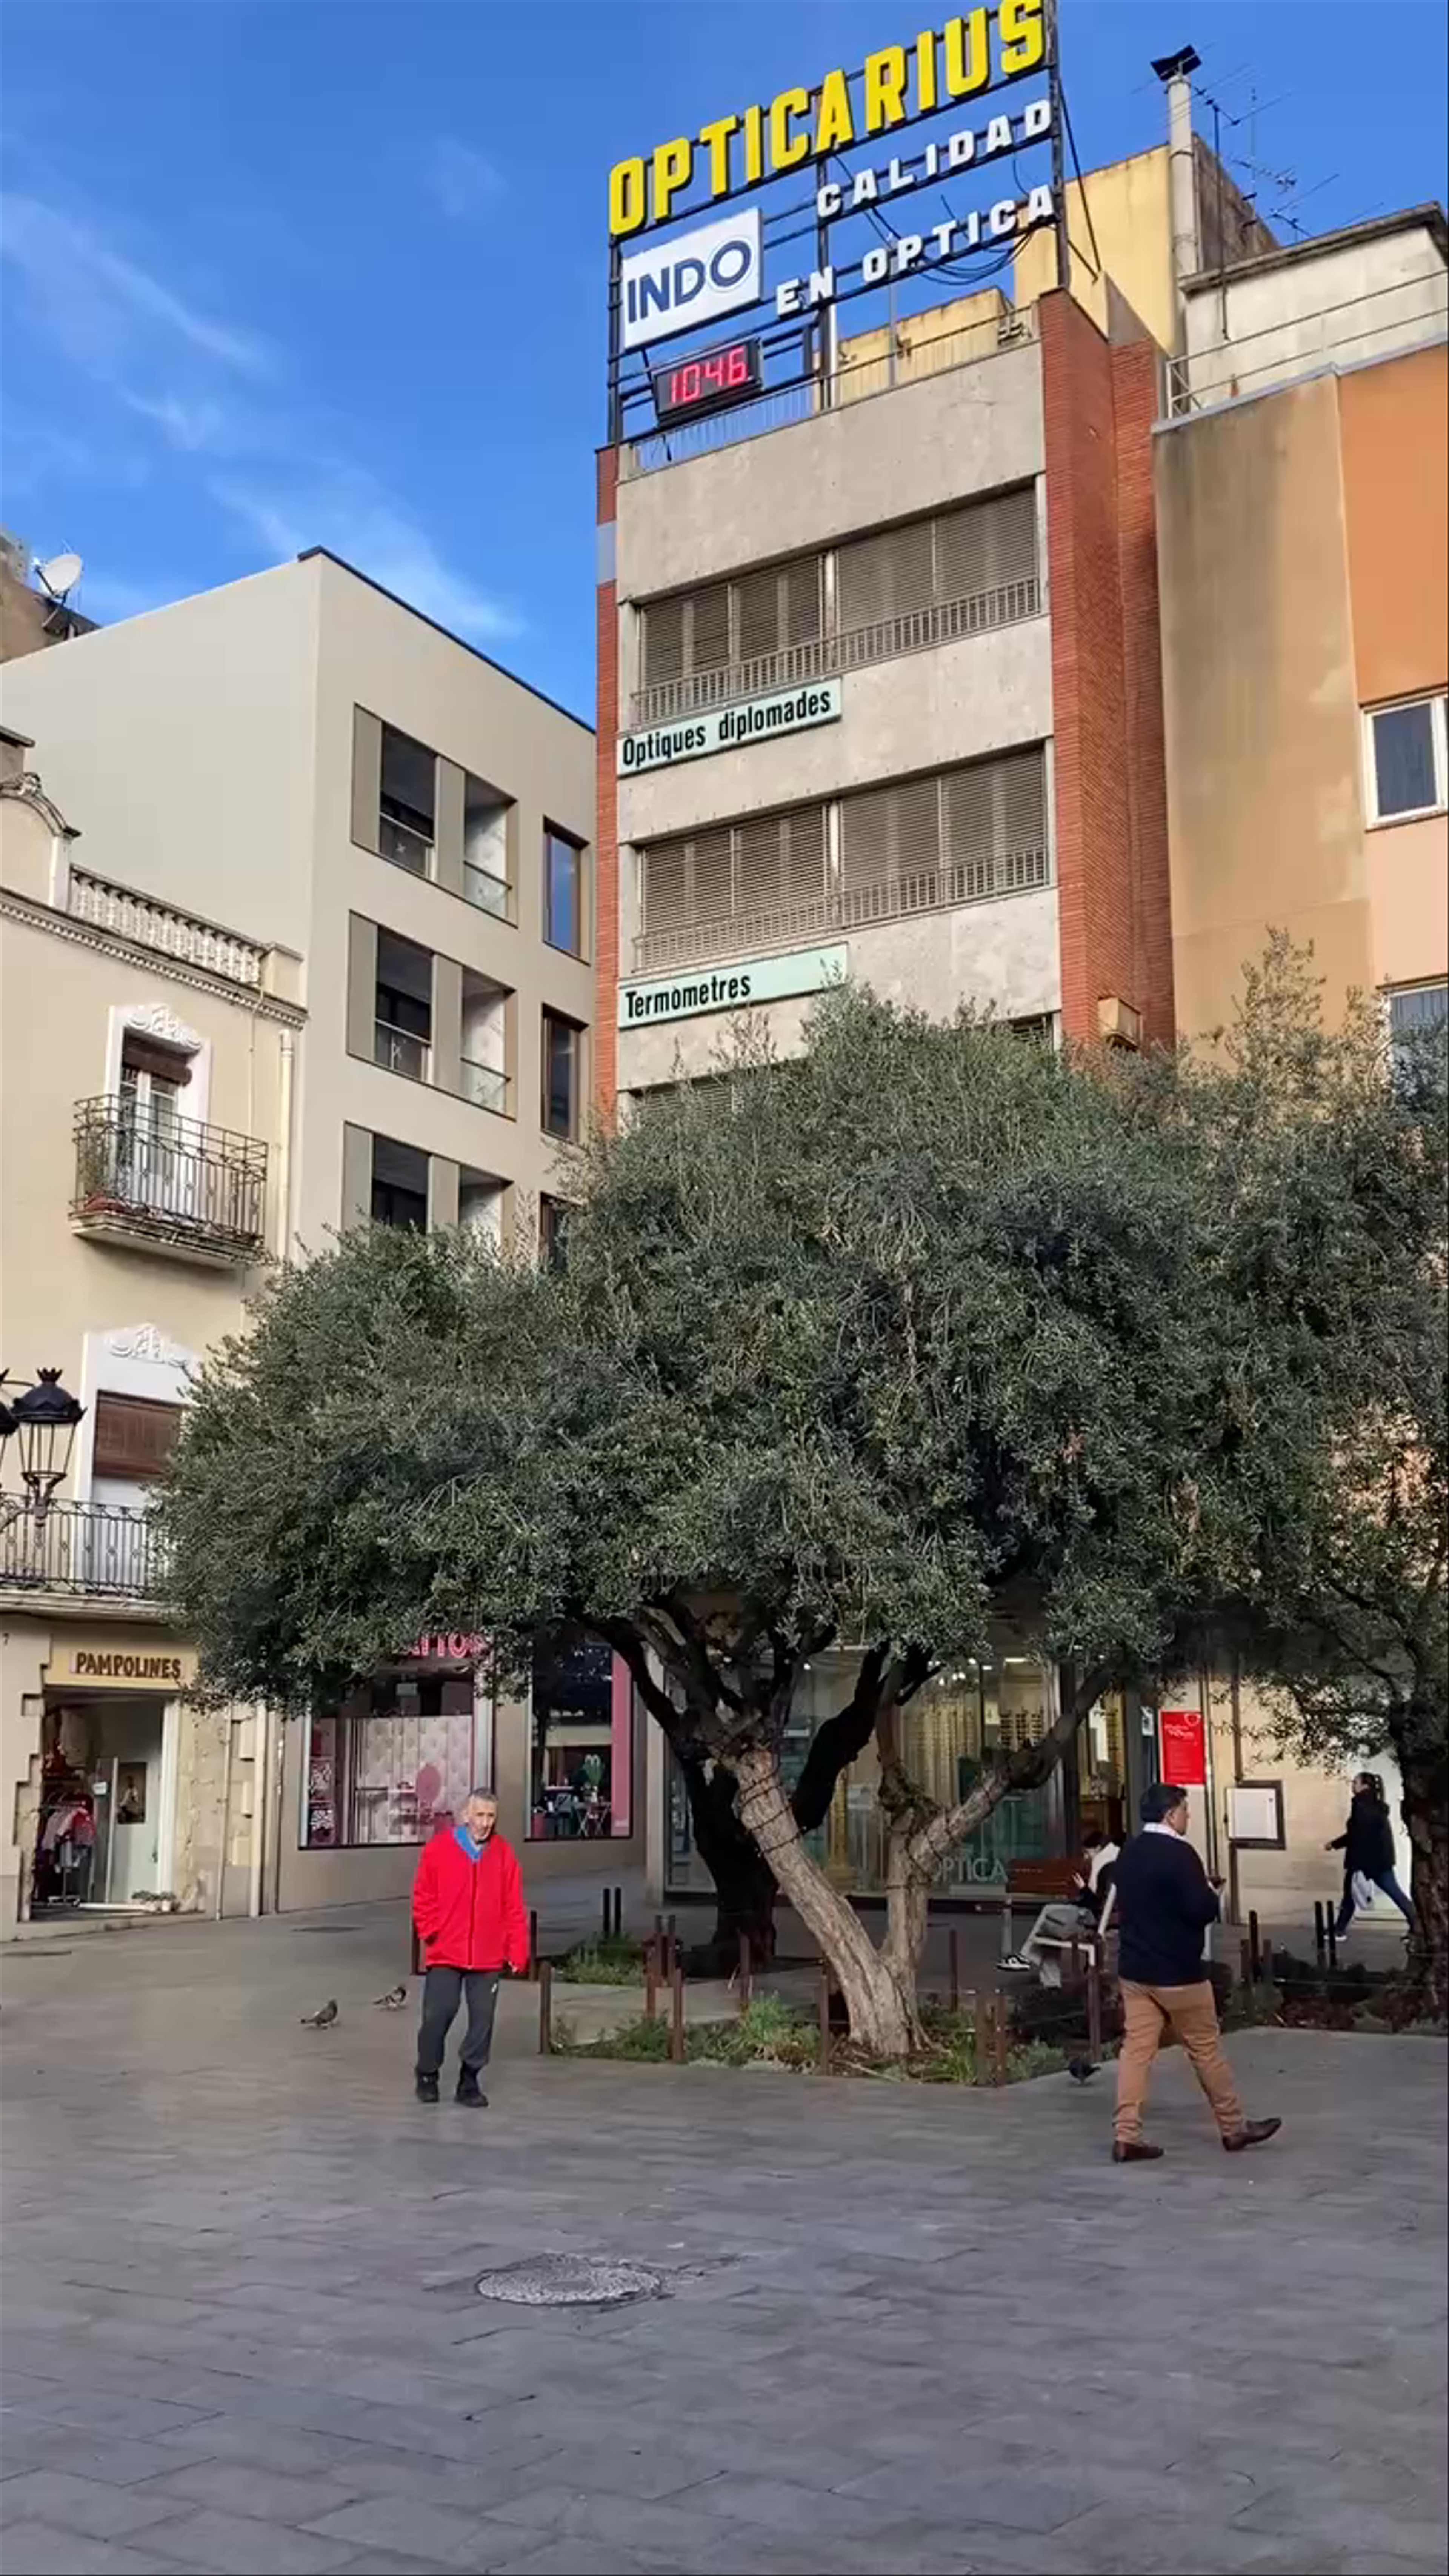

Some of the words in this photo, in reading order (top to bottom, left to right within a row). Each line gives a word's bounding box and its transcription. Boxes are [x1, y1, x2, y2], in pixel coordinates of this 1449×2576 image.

[609, 0, 1043, 235] OPTICARIUS
[817, 99, 1051, 218] CALIDAD
[627, 240, 751, 324] INDO
[776, 266, 833, 316] EN
[863, 183, 1054, 284] OPTICA
[671, 345, 746, 402] 1046
[623, 725, 706, 767] Optiques
[719, 691, 831, 740] diplomades
[77, 1652, 180, 1679] PAMPOLINES
